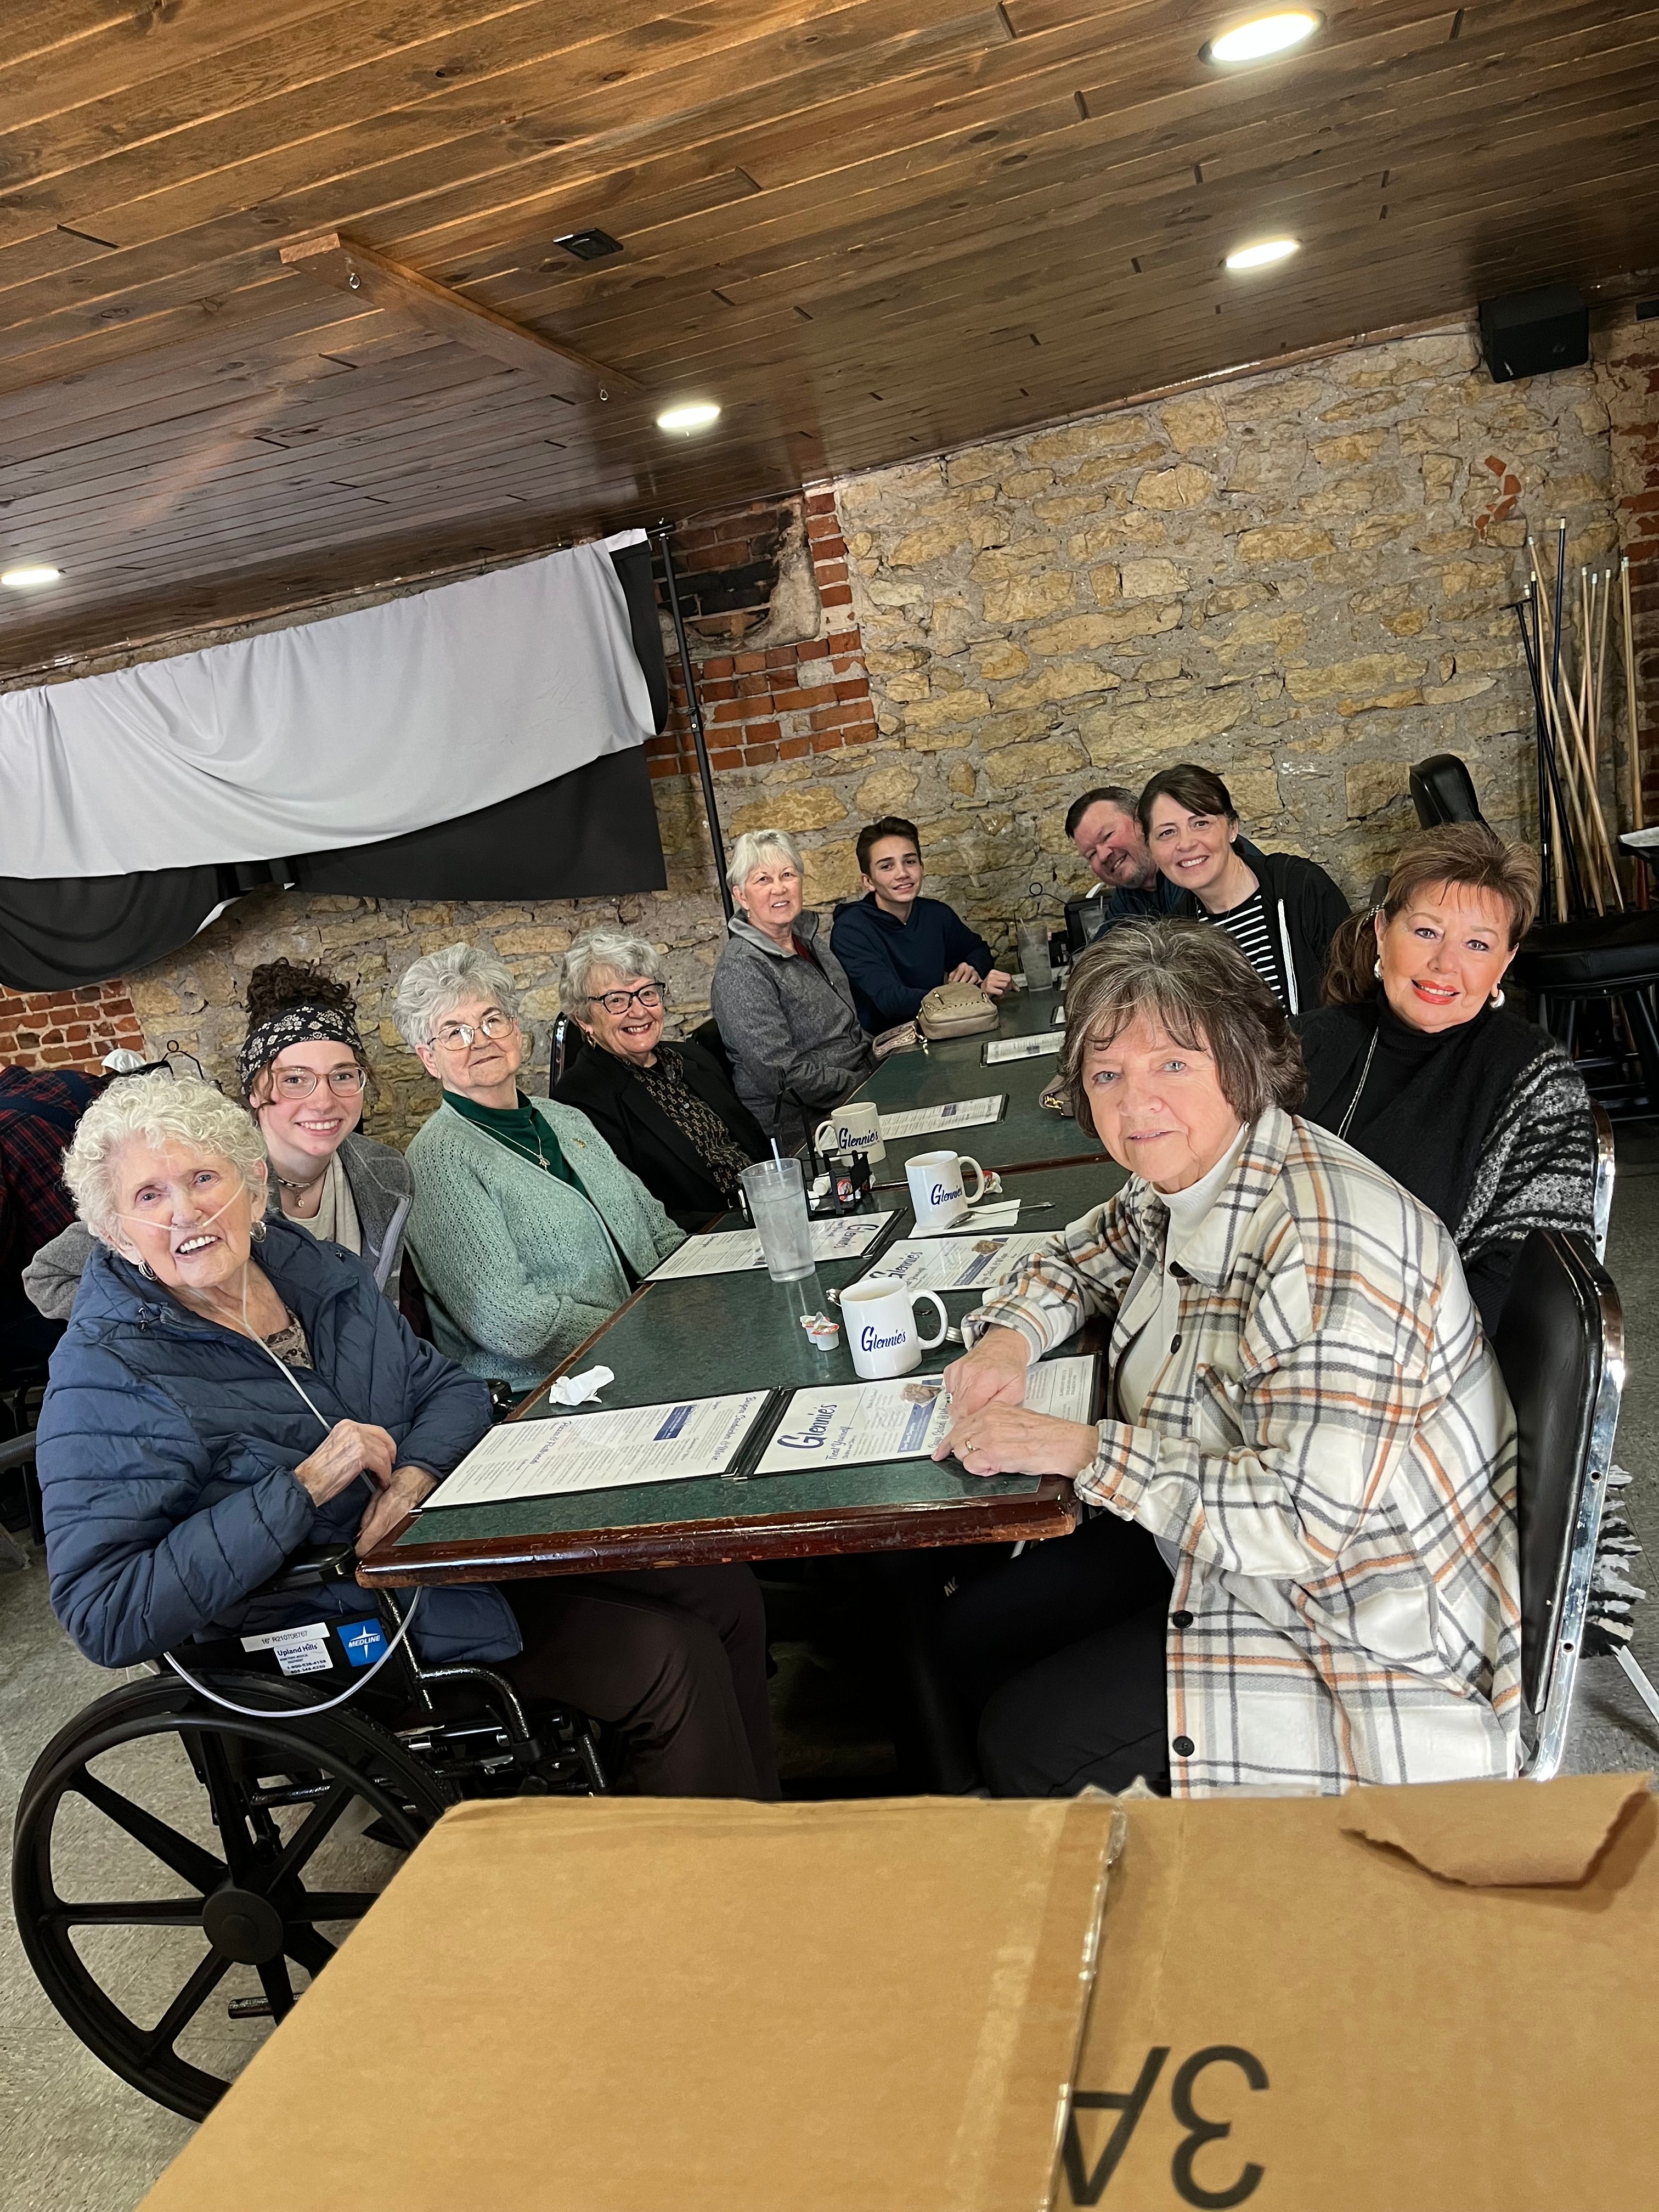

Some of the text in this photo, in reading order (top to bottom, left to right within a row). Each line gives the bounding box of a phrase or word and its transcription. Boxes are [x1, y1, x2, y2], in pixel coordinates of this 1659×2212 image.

[839, 1127, 878, 1150] Glennie's
[931, 1183, 963, 1205] Glennie's
[861, 1325, 906, 1352] Glennie's
[777, 1404, 837, 1448] Glennie's
[825, 1447, 840, 1460] Treat
[277, 1643, 318, 1657] Upland Hills
[348, 1635, 381, 1647] MEDLINE
